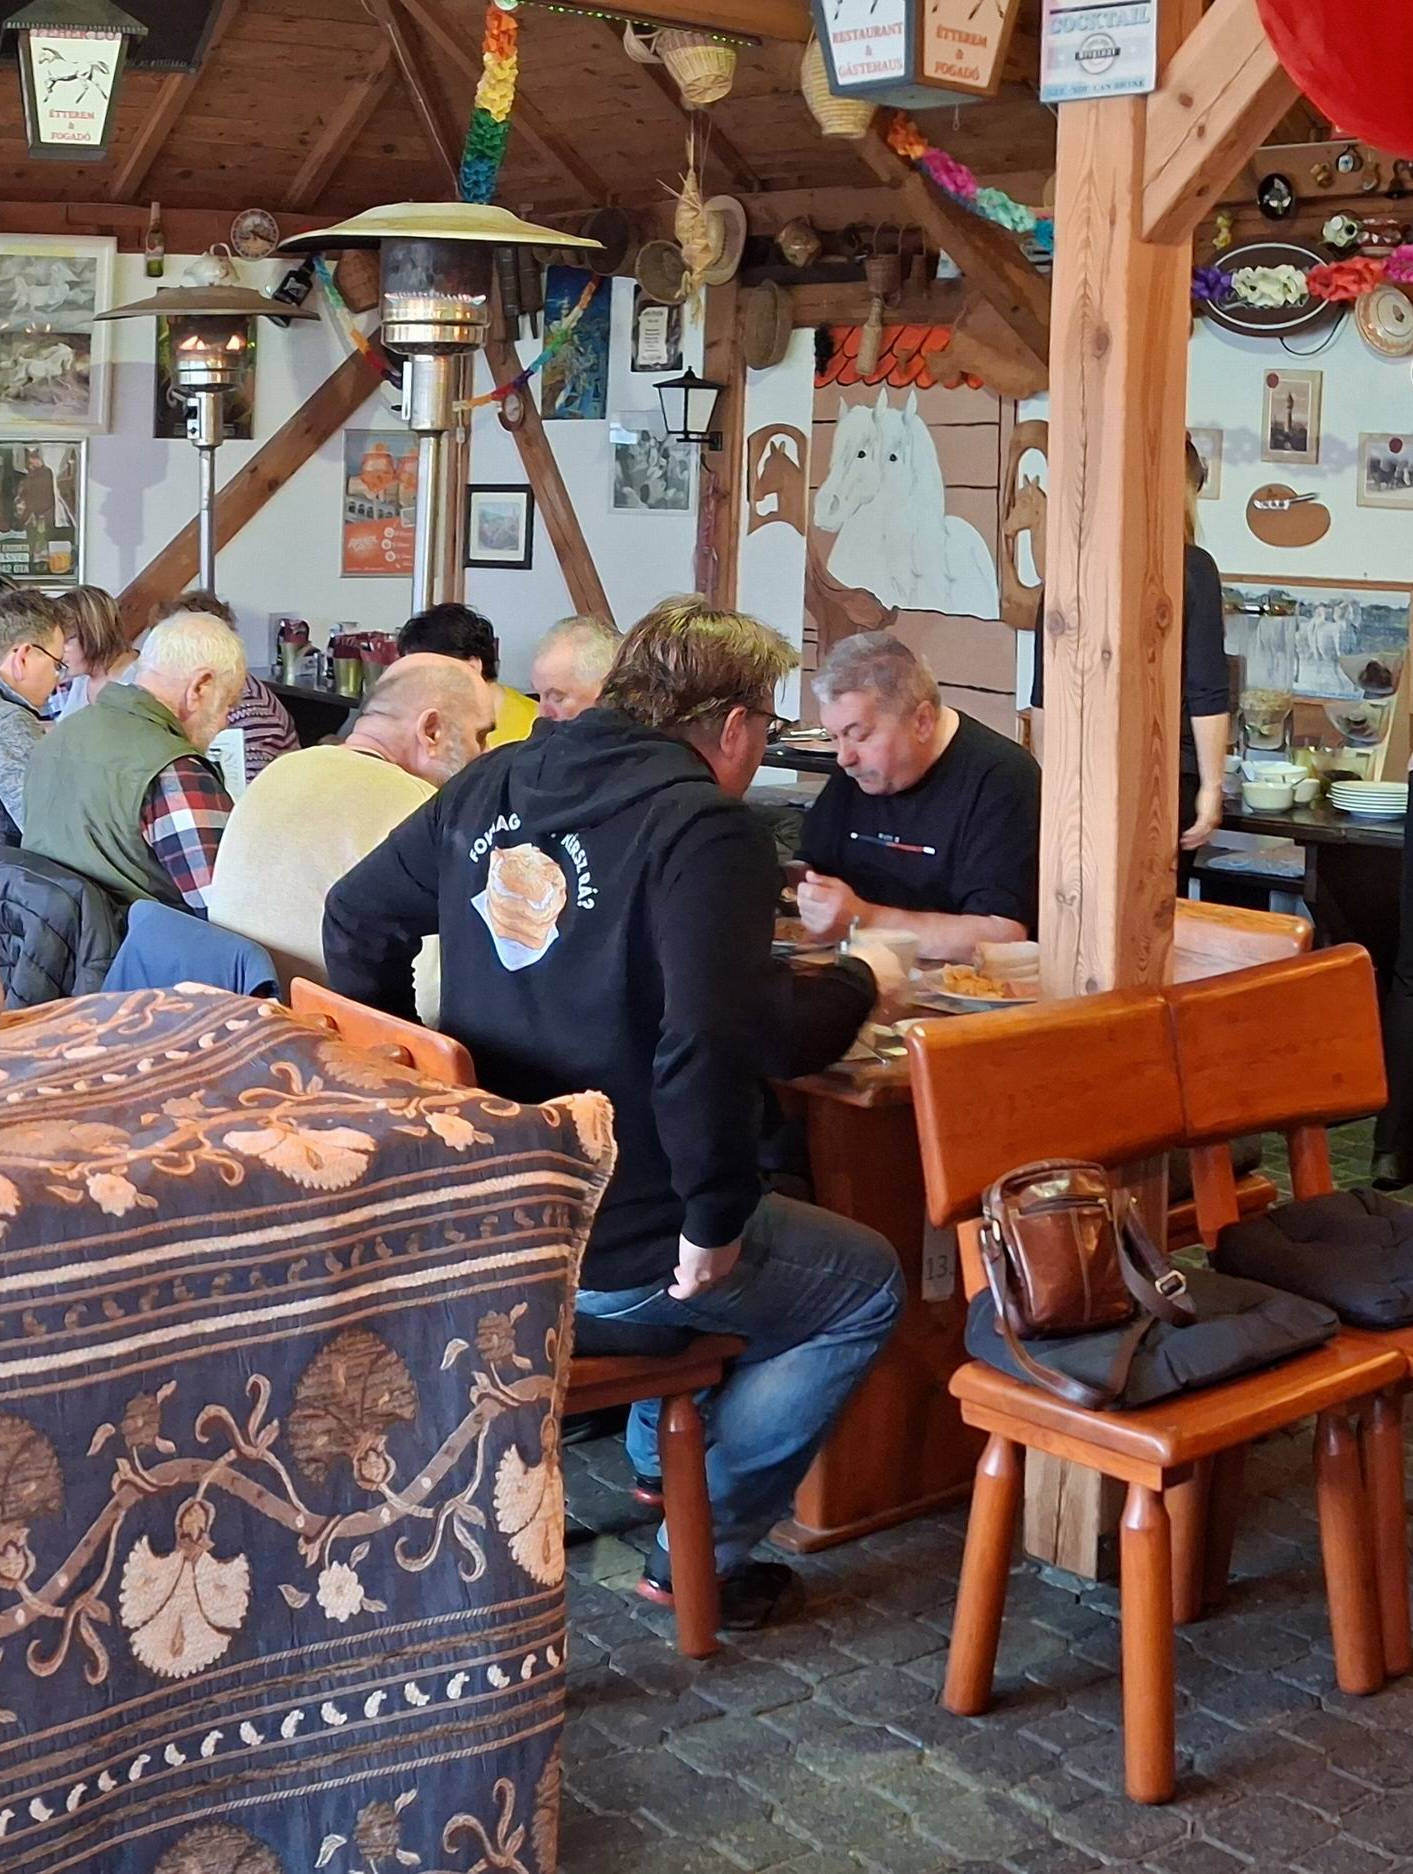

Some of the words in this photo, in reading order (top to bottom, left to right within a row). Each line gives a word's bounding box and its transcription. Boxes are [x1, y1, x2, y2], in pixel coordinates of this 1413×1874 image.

[1050, 7, 1151, 34] COCKTAIL
[832, 23, 903, 43] RESTAURANT
[49, 109, 95, 120] ÉTTEREM
[51, 131, 91, 141] FOGADÓ
